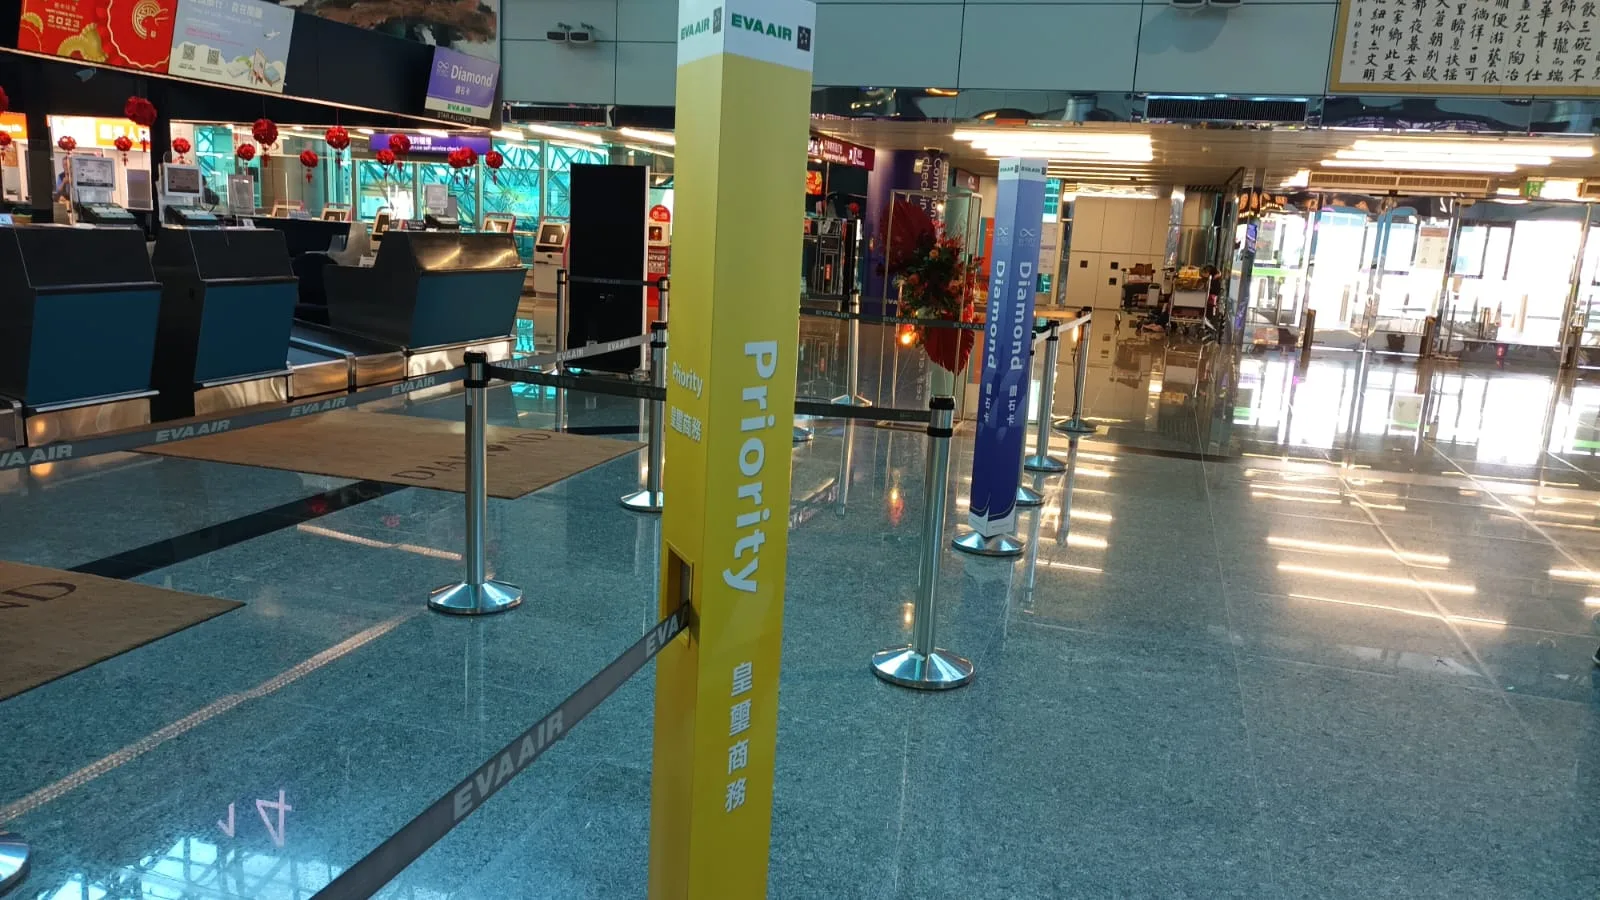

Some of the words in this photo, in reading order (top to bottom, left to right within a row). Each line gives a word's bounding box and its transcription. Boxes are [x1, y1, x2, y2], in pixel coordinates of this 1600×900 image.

[731, 13, 764, 34] EVA
[766, 24, 792, 41] AIR
[451, 64, 493, 88] Diamond
[987, 261, 1006, 369] Diamond
[1010, 261, 1032, 371] Diamond
[672, 360, 703, 400] Priority
[28, 444, 73, 462] AIR
[155, 426, 195, 443] EVA
[196, 420, 231, 435] AIR
[722, 340, 778, 593] Priority
[454, 751, 515, 821] EVA
[516, 709, 563, 768] AIR
[725, 660, 753, 813] 皇璽商務
